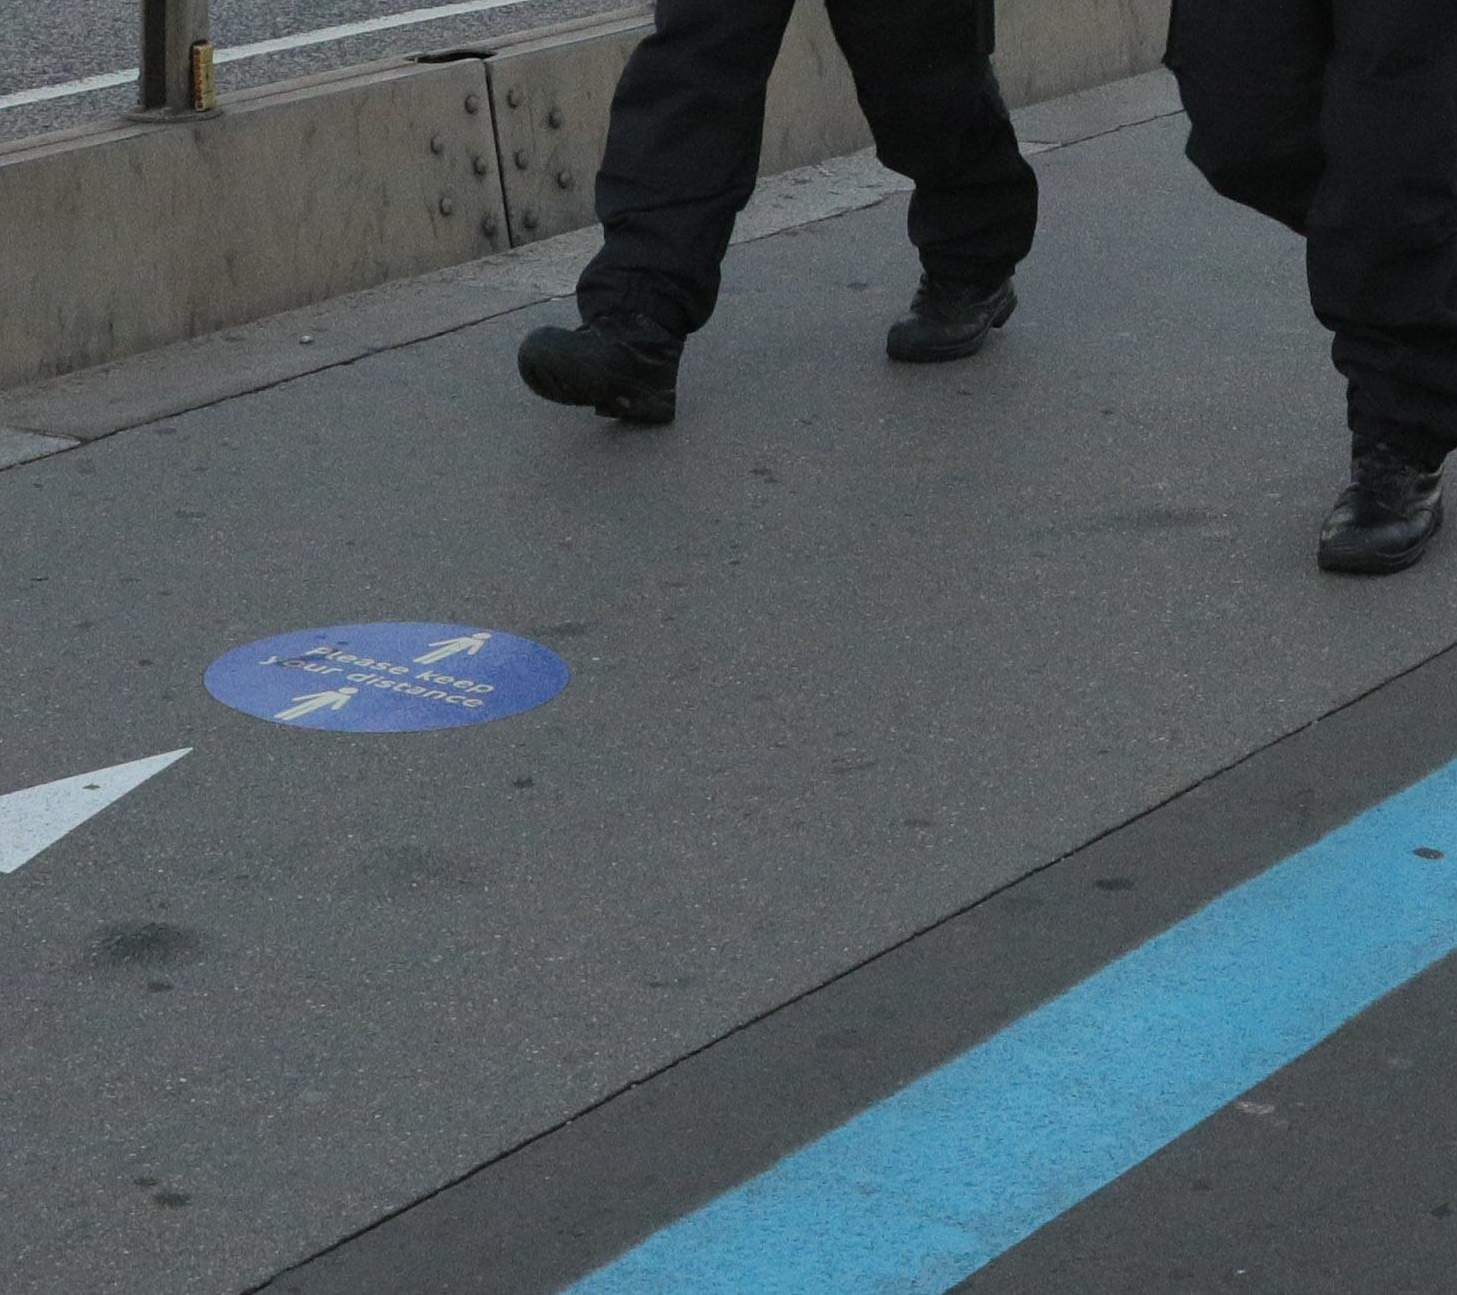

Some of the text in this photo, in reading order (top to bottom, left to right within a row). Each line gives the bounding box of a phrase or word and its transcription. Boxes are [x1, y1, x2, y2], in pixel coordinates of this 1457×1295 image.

[259, 655, 486, 709] your distance
[304, 646, 496, 696] Please keep
